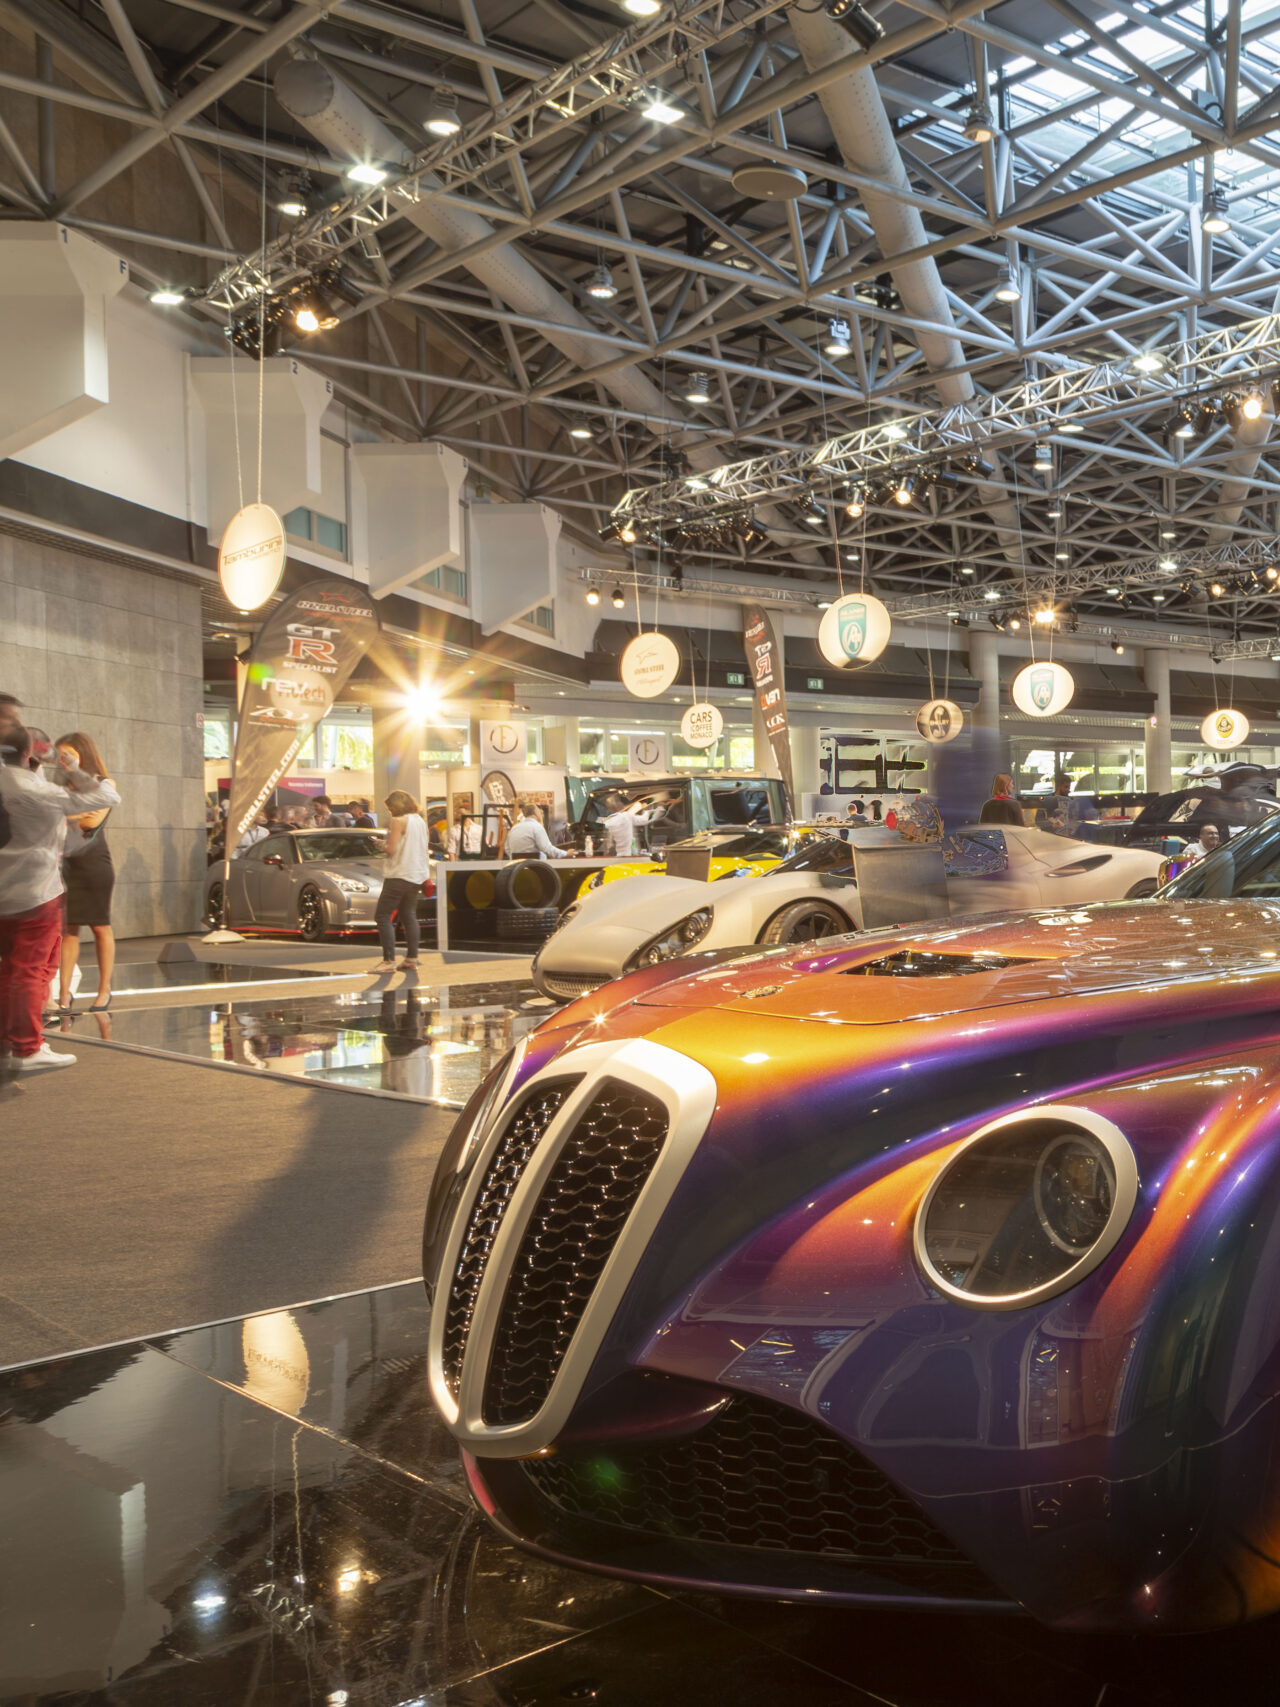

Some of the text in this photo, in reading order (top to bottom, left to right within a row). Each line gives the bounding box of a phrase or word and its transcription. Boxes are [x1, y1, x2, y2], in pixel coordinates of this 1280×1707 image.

[286, 623, 341, 640] GT
[285, 636, 338, 664] R
[282, 661, 338, 674] SPECIALIST
[689, 710, 713, 724] CARS
